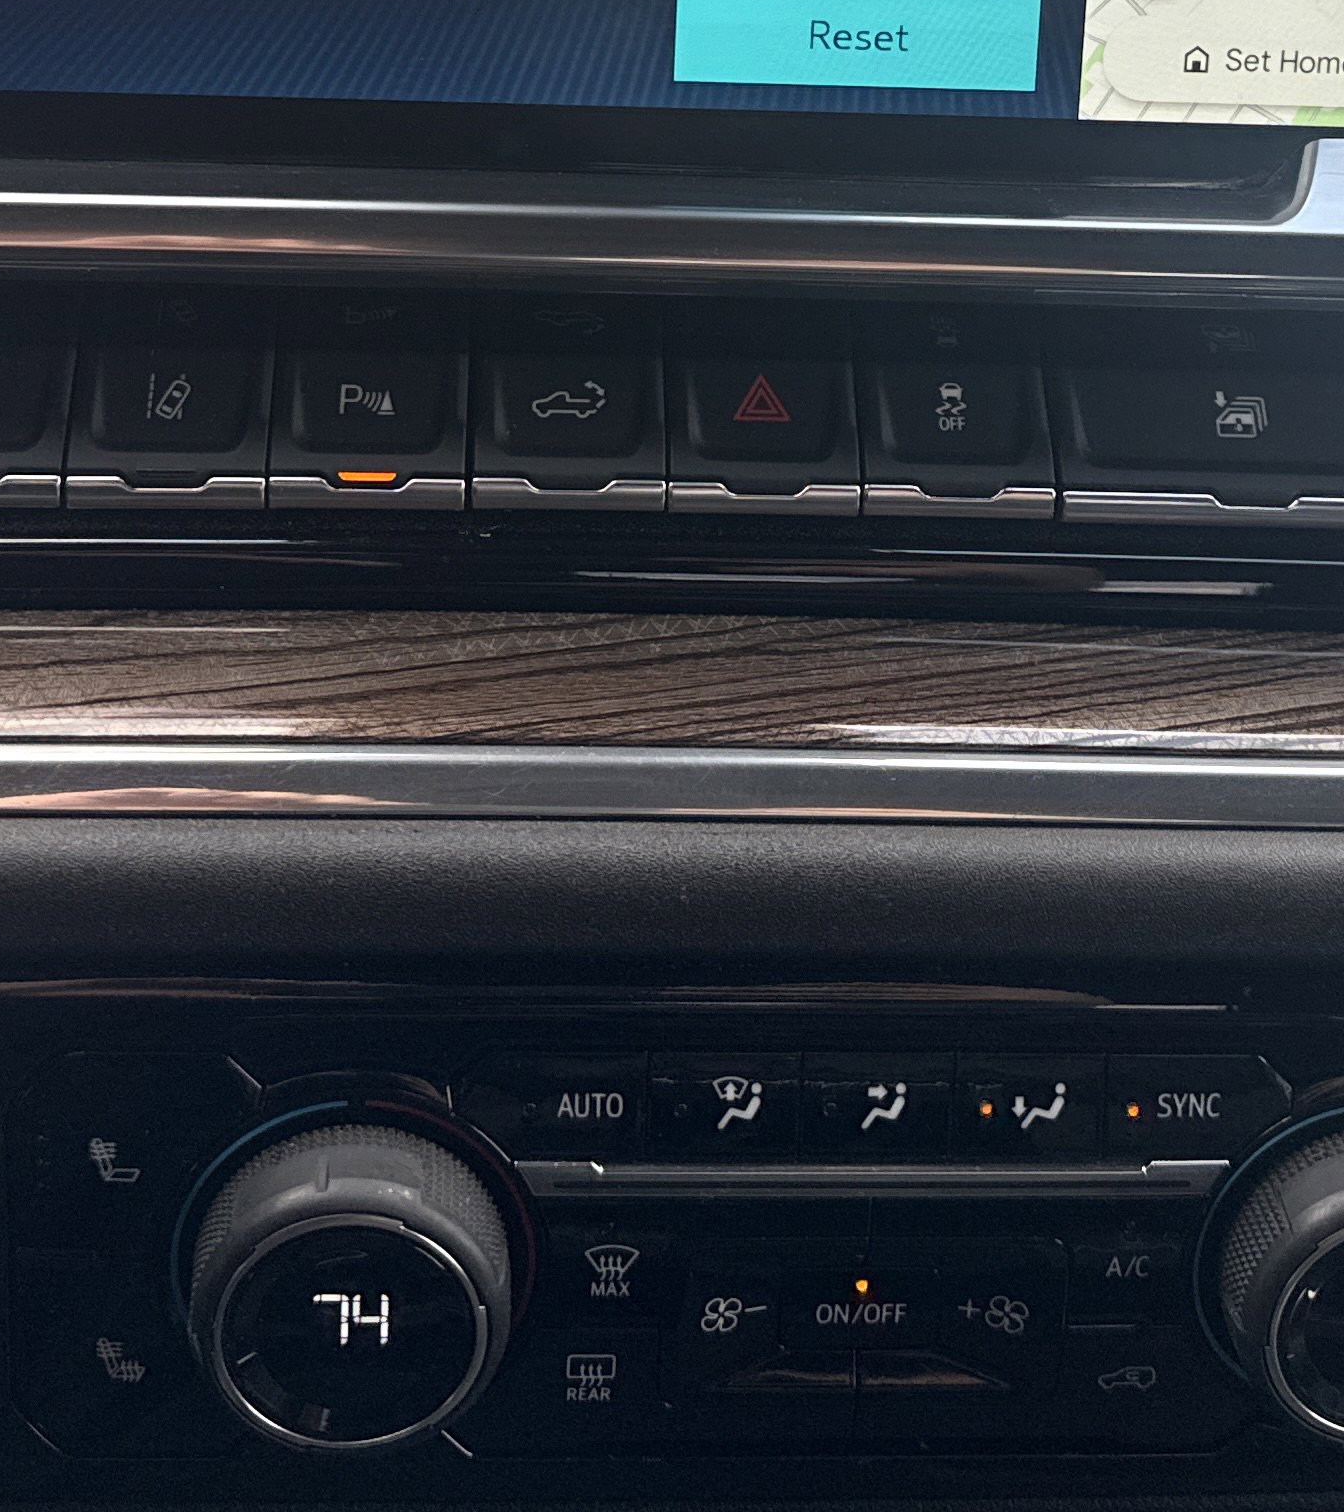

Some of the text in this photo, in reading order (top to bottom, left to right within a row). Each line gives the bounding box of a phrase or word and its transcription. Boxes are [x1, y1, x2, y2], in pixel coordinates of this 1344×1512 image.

[809, 19, 909, 52] Reset
[1225, 47, 1271, 73] Set
[938, 416, 967, 432] OFF
[557, 1092, 624, 1119] AUTO
[1157, 1092, 1221, 1118] SYNC
[1105, 1255, 1150, 1277] A/C
[590, 1281, 631, 1297] MAX
[312, 1293, 389, 1345] 74
[815, 1303, 908, 1324] ON/OFF
[566, 1386, 613, 1402] REAR
